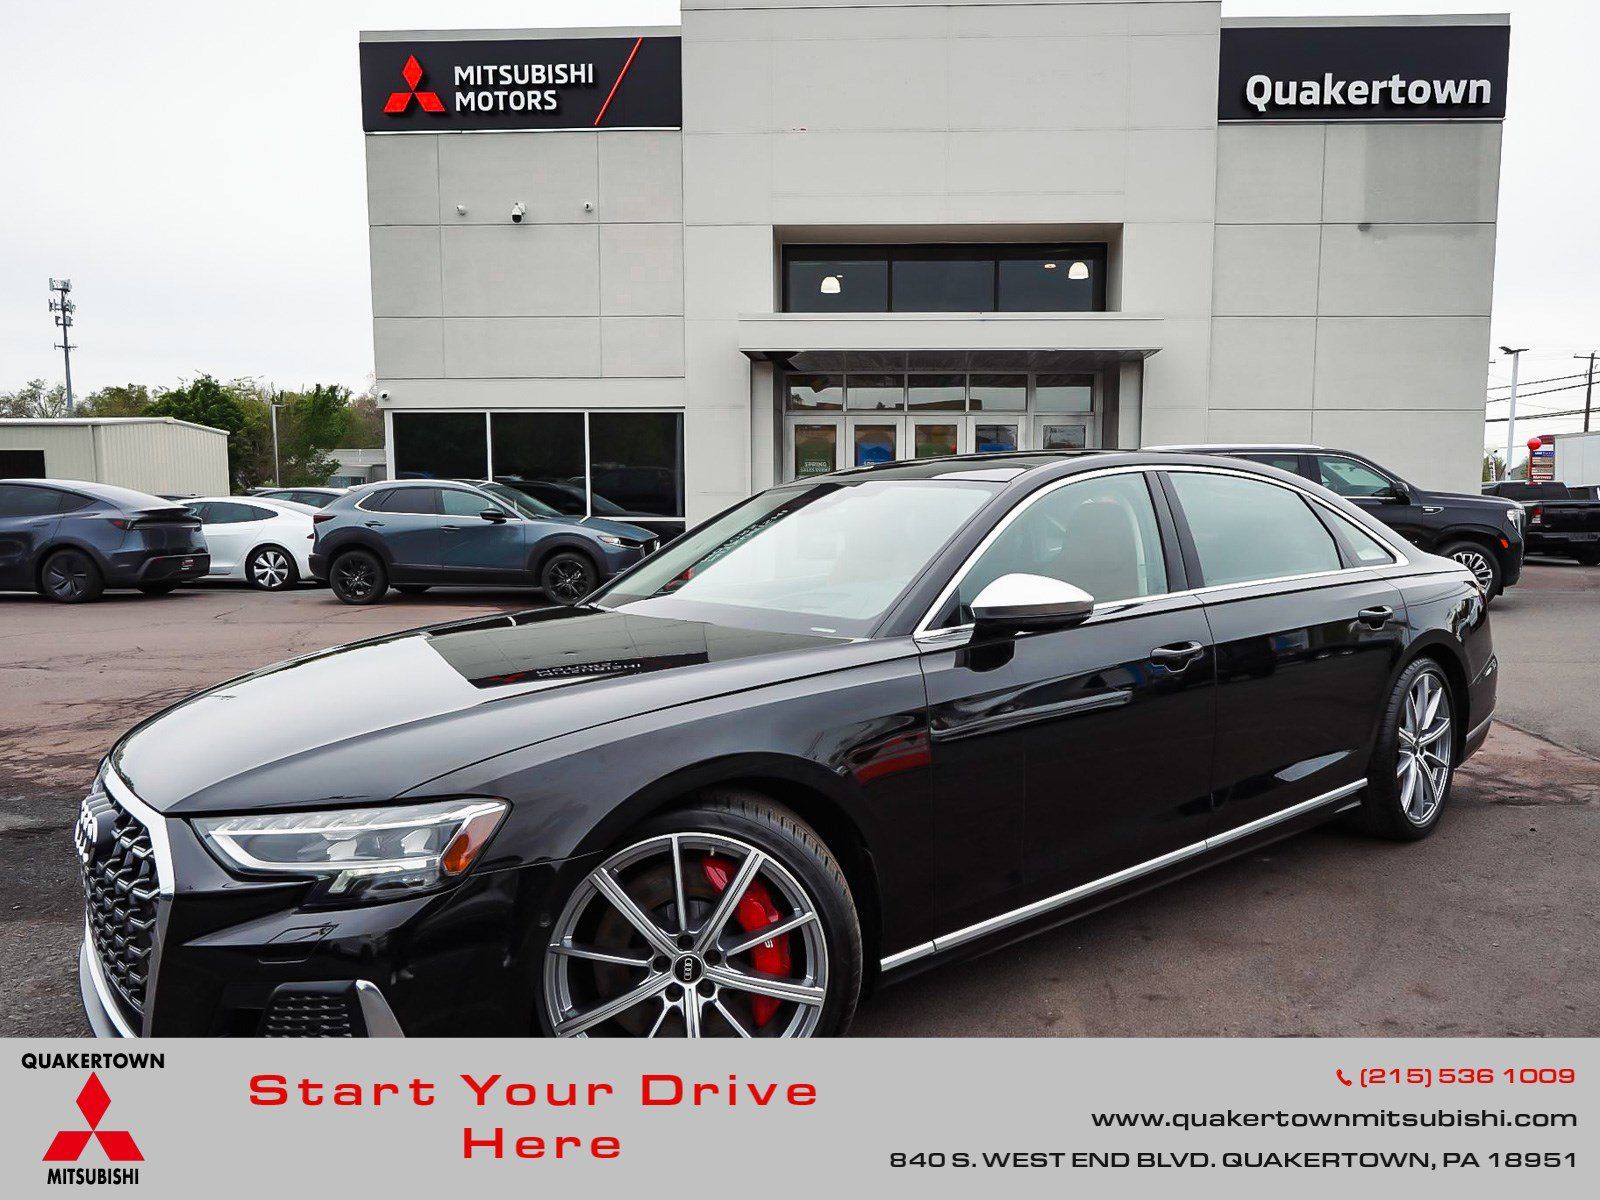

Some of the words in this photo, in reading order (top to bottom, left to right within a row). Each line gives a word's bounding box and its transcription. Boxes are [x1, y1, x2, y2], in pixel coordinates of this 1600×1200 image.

[454, 63, 594, 86] MITSUBISHI
[455, 90, 557, 112] MOTORS
[1246, 72, 1492, 112] Quakertown
